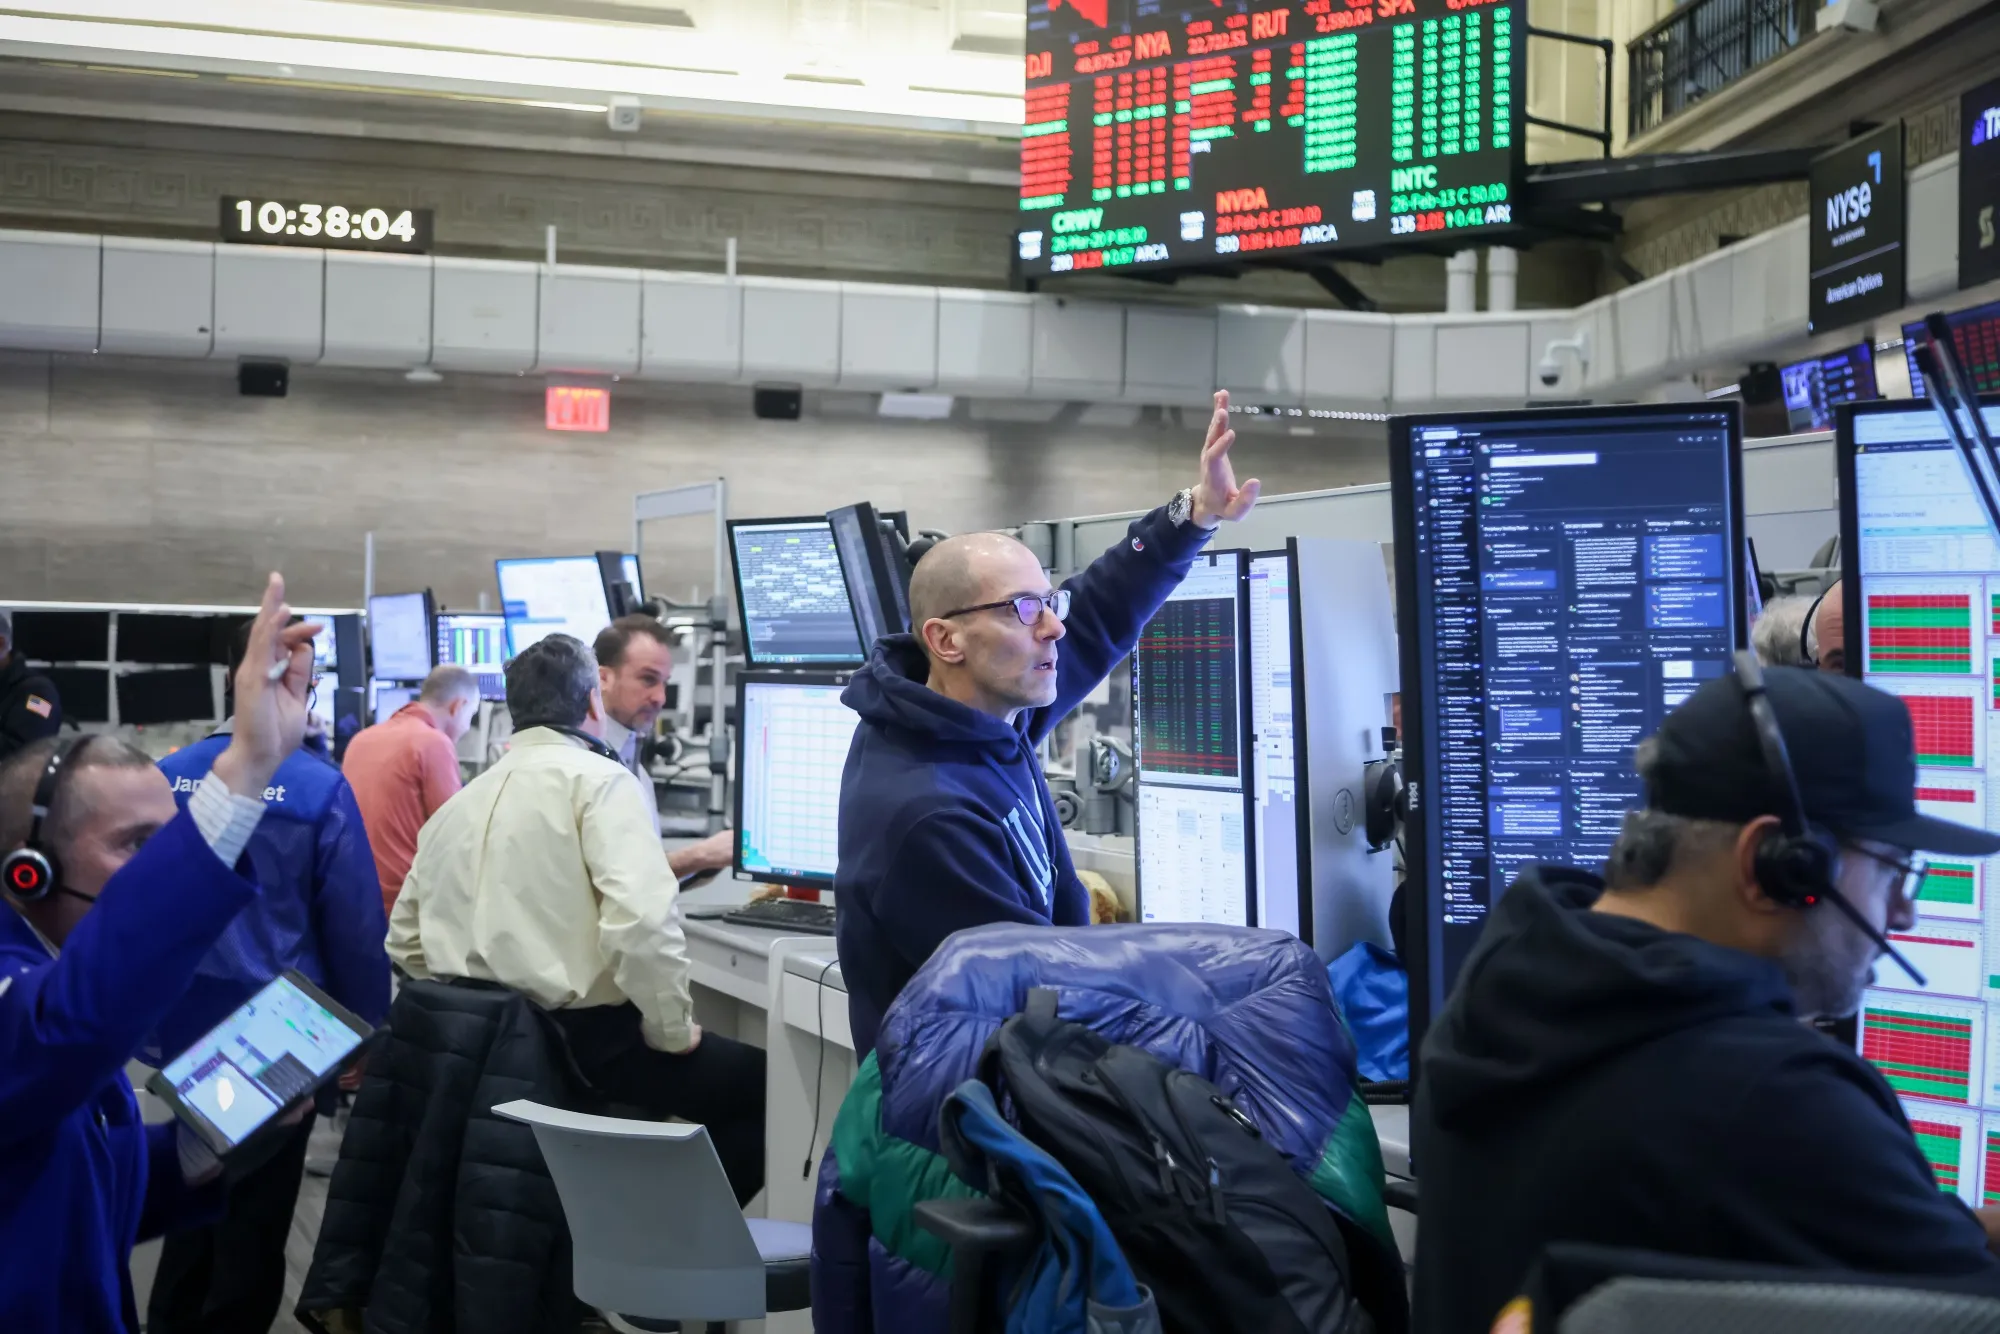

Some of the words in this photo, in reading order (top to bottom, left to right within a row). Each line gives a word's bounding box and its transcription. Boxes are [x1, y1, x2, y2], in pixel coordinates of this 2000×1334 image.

[1252, 8, 1290, 40] RUT
[1135, 30, 1171, 60] NYA
[1391, 165, 1437, 192] INTC
[1216, 187, 1268, 214] NVDA
[236, 200, 416, 242] 10:38:04
[1301, 224, 1338, 244] ARCA
[1827, 282, 1857, 304] American
[1855, 272, 1884, 295] Options
[170, 776, 201, 793] Jan
[1409, 782, 1418, 810] DELL
